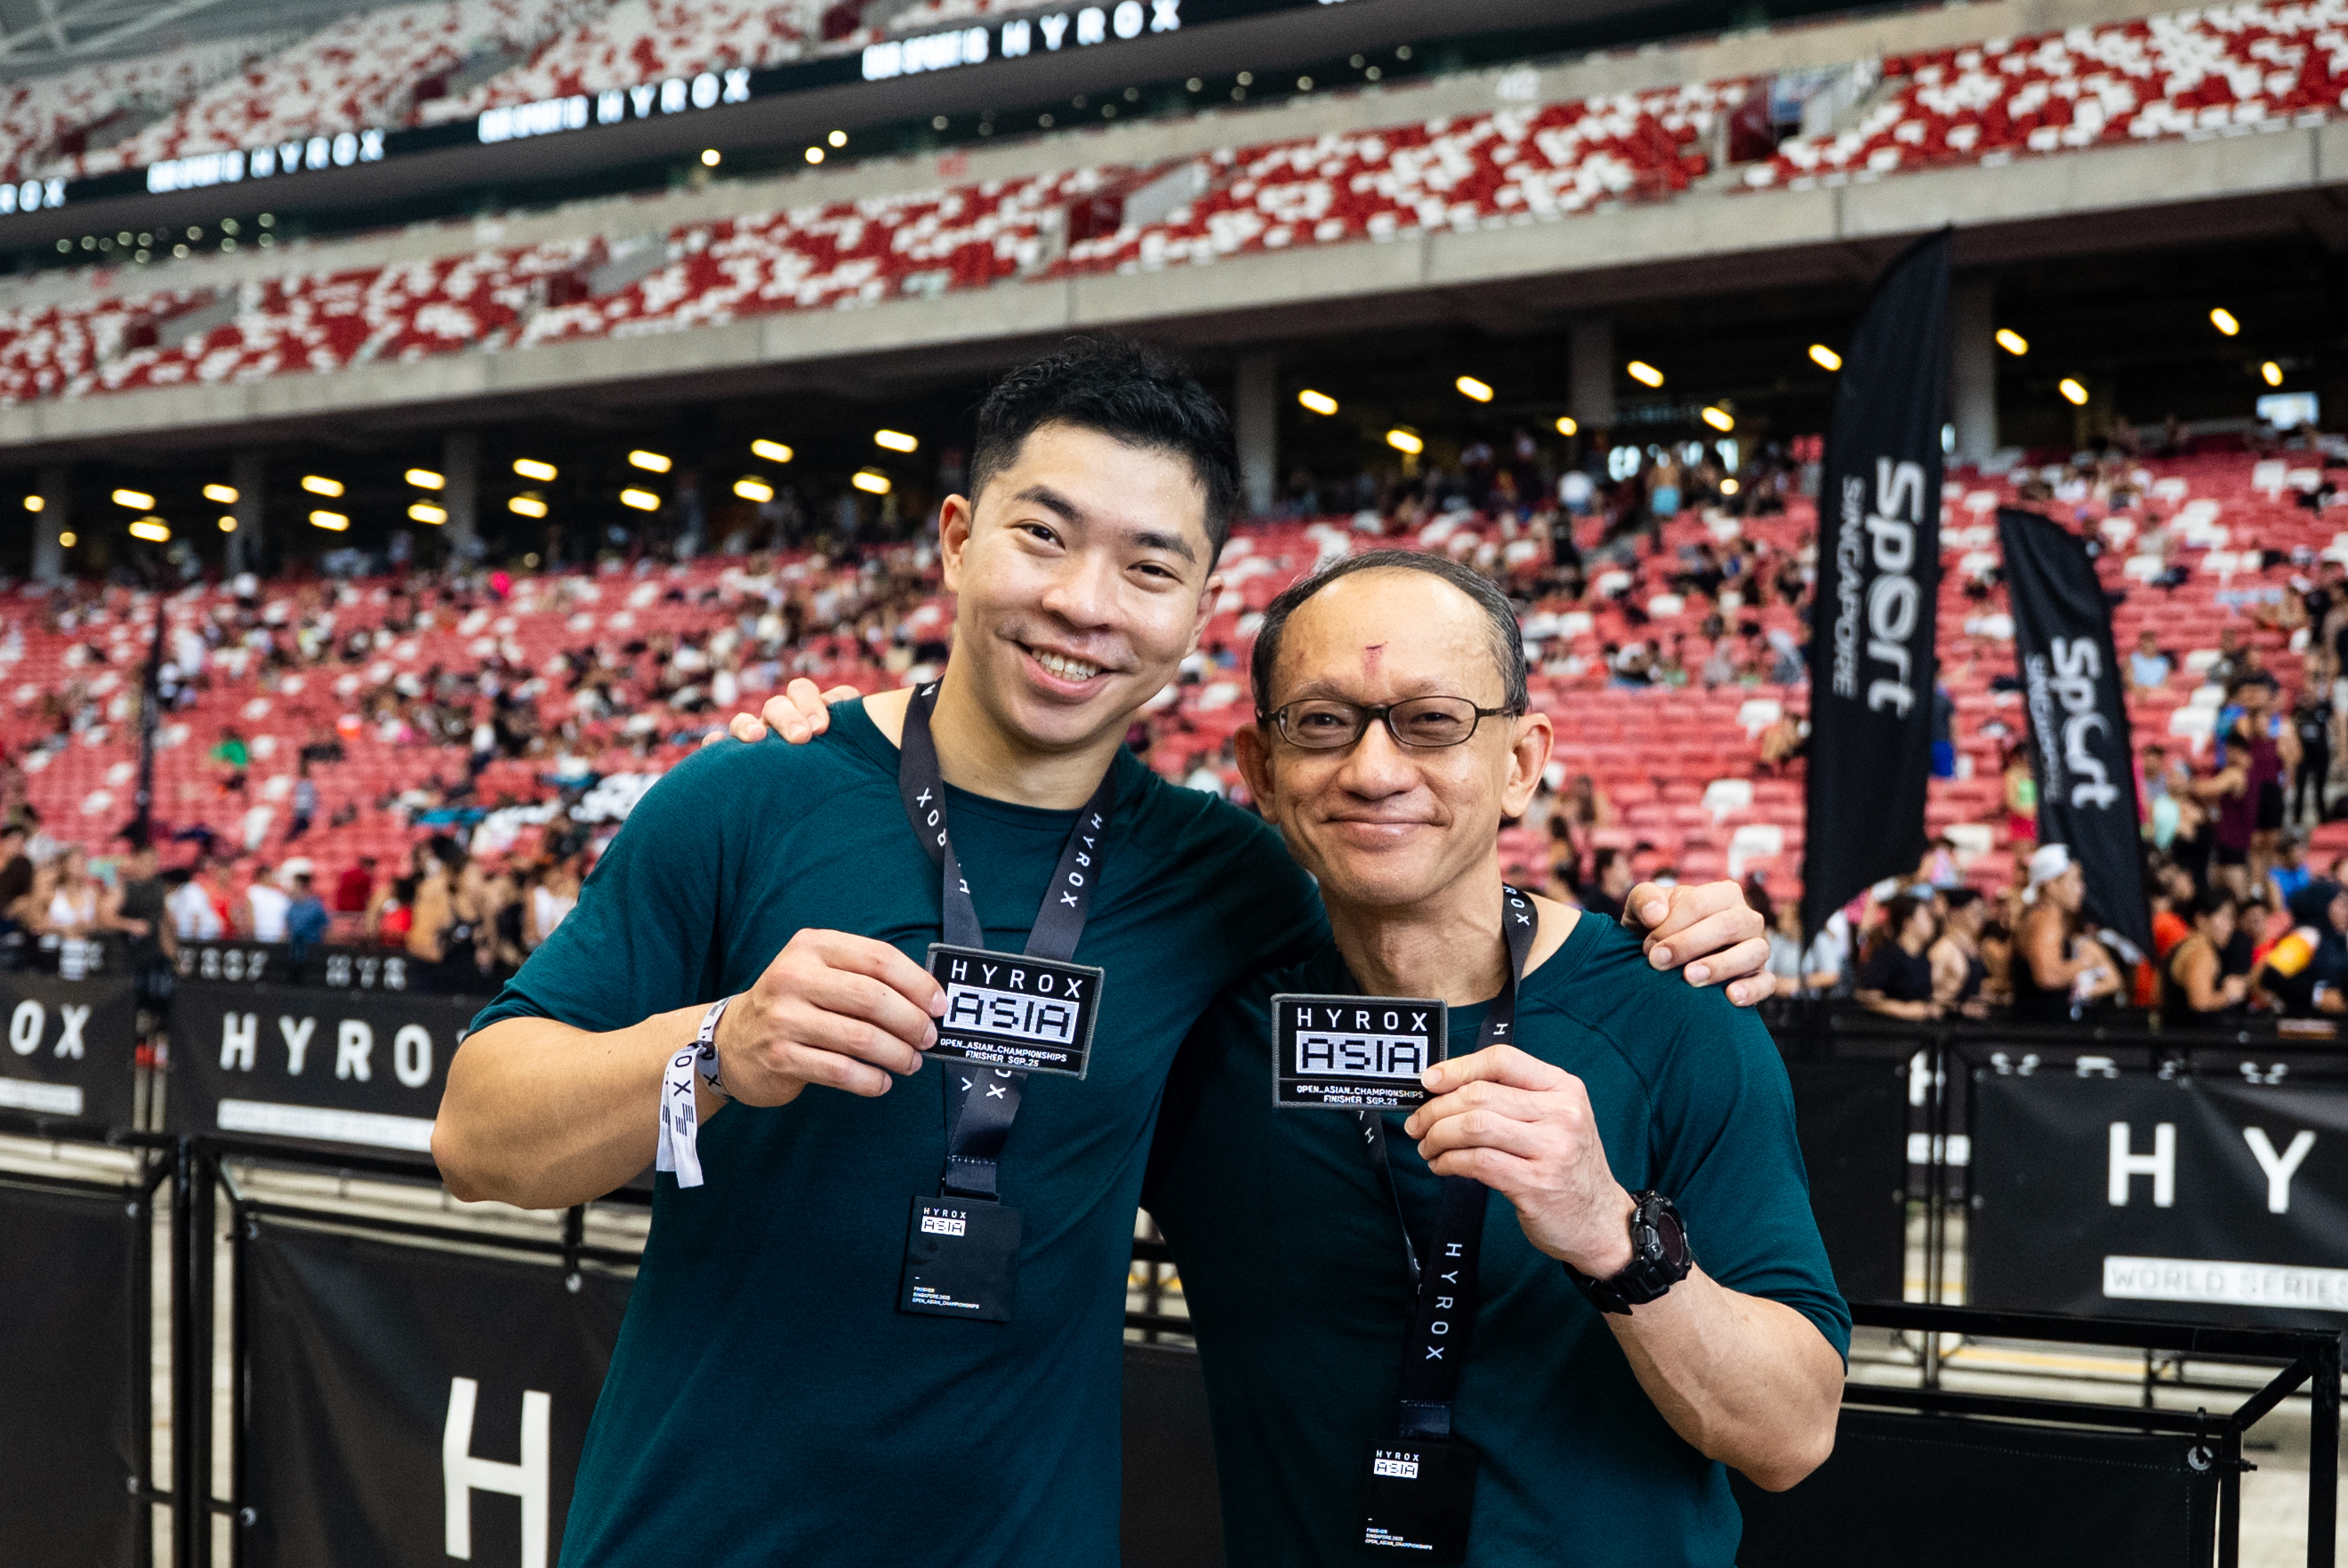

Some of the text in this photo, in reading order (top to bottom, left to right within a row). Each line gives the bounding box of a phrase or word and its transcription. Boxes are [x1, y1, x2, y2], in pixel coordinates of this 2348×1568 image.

[1001, 0, 1181, 58] HYROX
[597, 67, 751, 125] HYROX
[250, 128, 384, 178] HYROX
[1832, 474, 1866, 700] SINGAPORE
[1060, 813, 1103, 907] HYROX
[951, 960, 1083, 998] HYROX
[949, 992, 1071, 1038] ASIA
[1297, 1007, 1427, 1031] HYROX
[219, 1011, 469, 1088] HYRO
[940, 1038, 1067, 1062] OPEN_ASIAN_CHAMPIONSHIPS
[965, 1050, 1004, 1063] FINISHER
[1302, 1038, 1420, 1073] ASIA
[1297, 1085, 1423, 1098] OPEN_ASIAN_CHAMPIONSHIPS
[1323, 1095, 1363, 1105] FINISHER
[2108, 1122, 2316, 1214] HY
[923, 1207, 967, 1219] HYROX
[923, 1218, 963, 1234] ASIA
[2112, 1262, 2223, 1291] WORLD
[1426, 1243, 1463, 1360] HYROX
[1376, 1450, 1419, 1461] HYROX
[1376, 1461, 1416, 1476] ASIA
